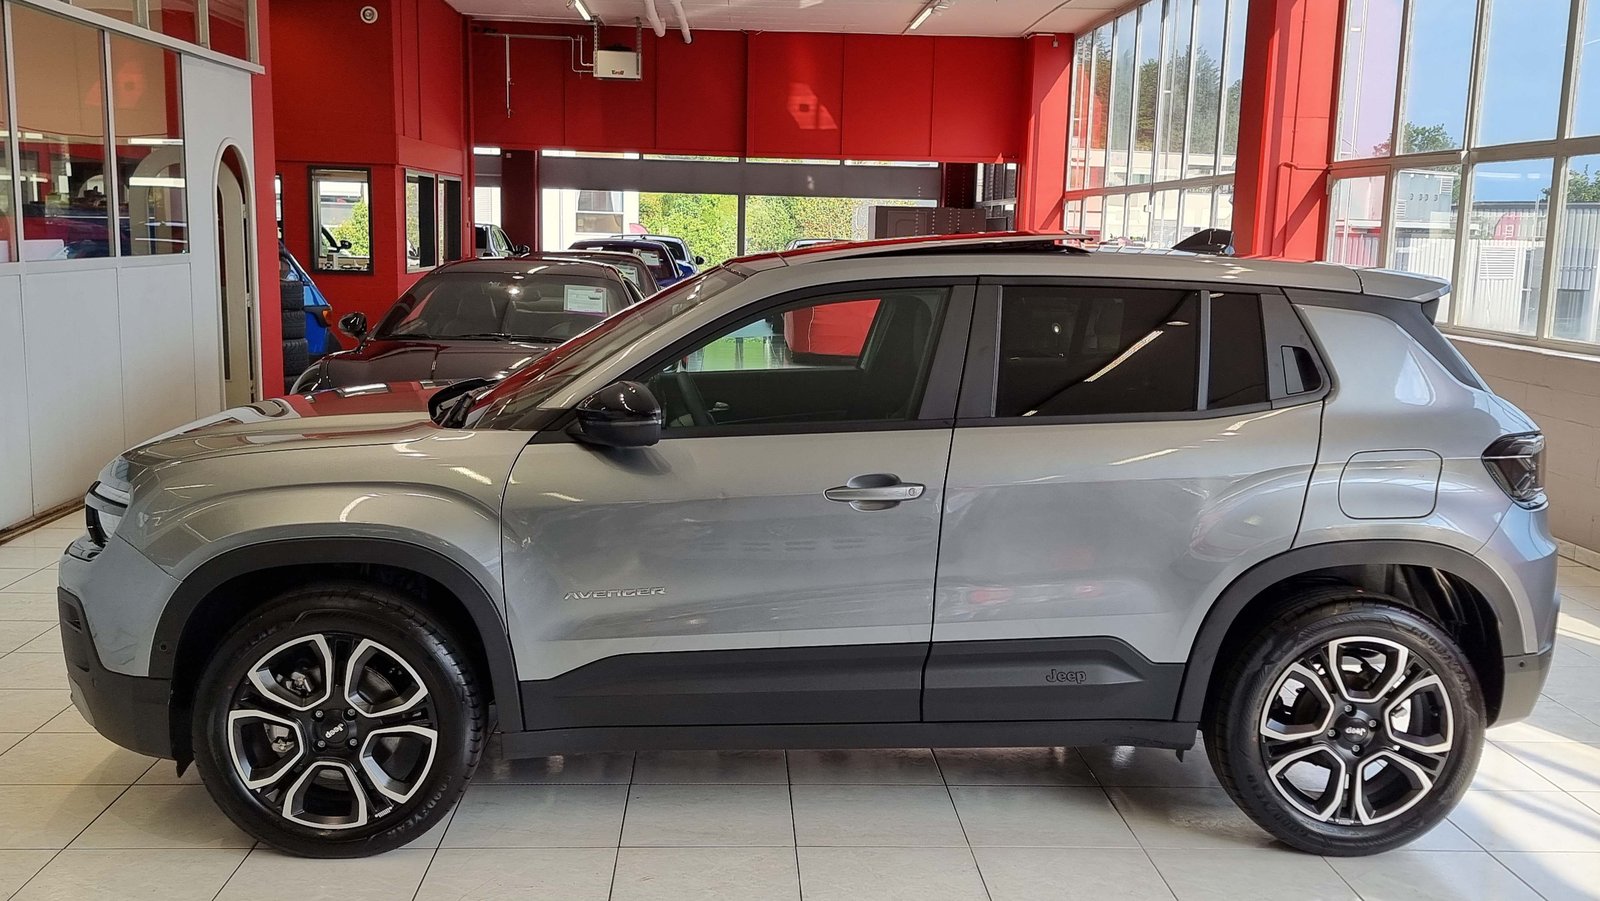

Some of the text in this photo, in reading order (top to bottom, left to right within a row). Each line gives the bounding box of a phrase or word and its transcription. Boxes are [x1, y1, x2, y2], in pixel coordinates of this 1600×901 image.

[564, 587, 666, 600] AVENGER
[1045, 668, 1087, 685] Jeep
[325, 722, 345, 739] Jeep
[1345, 726, 1367, 736] Jeep
